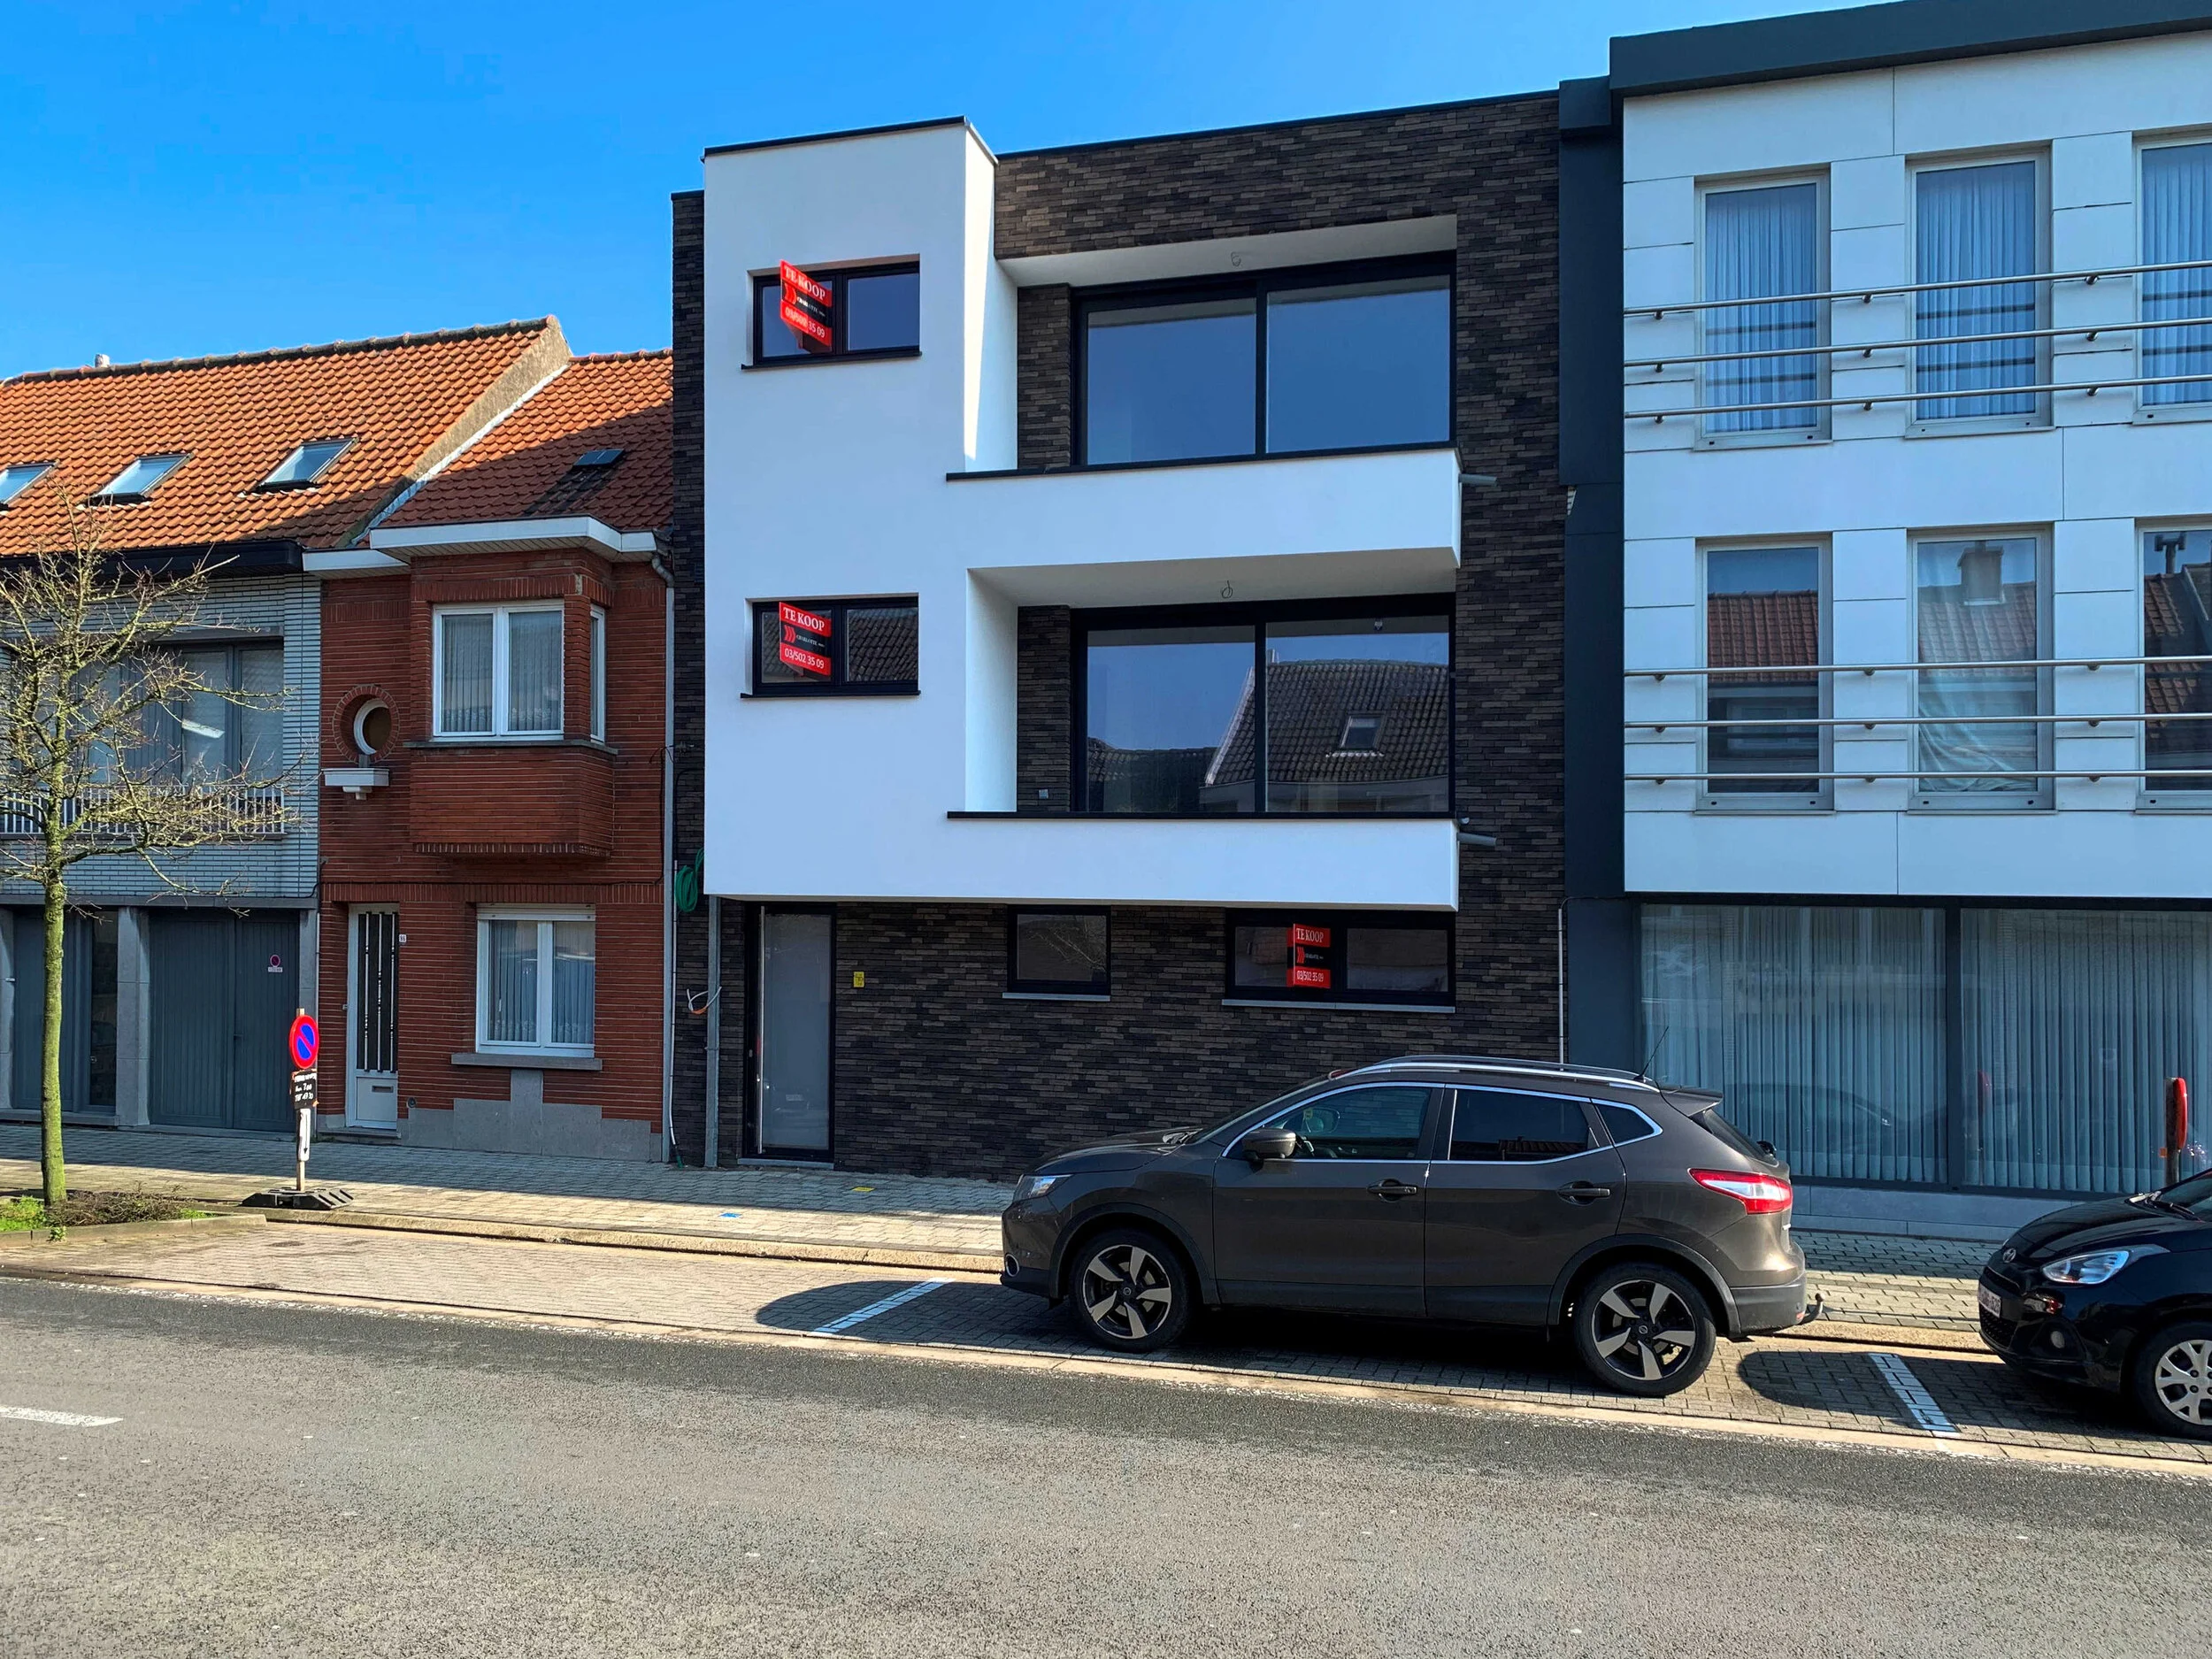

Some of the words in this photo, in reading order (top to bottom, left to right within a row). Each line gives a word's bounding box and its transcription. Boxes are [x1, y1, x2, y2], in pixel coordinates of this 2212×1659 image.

[784, 265, 796, 283] TE
[798, 274, 826, 300] KOOP
[808, 320, 816, 333] 35
[817, 326, 826, 338] 09
[783, 607, 796, 622] TE
[797, 612, 825, 631] KOOP
[784, 648, 806, 664] 03/502
[807, 656, 816, 665] 35
[816, 658, 825, 669] 09
[1296, 928, 1305, 941] TE
[1305, 930, 1324, 943] KOOP
[1317, 973, 1324, 982] 09
